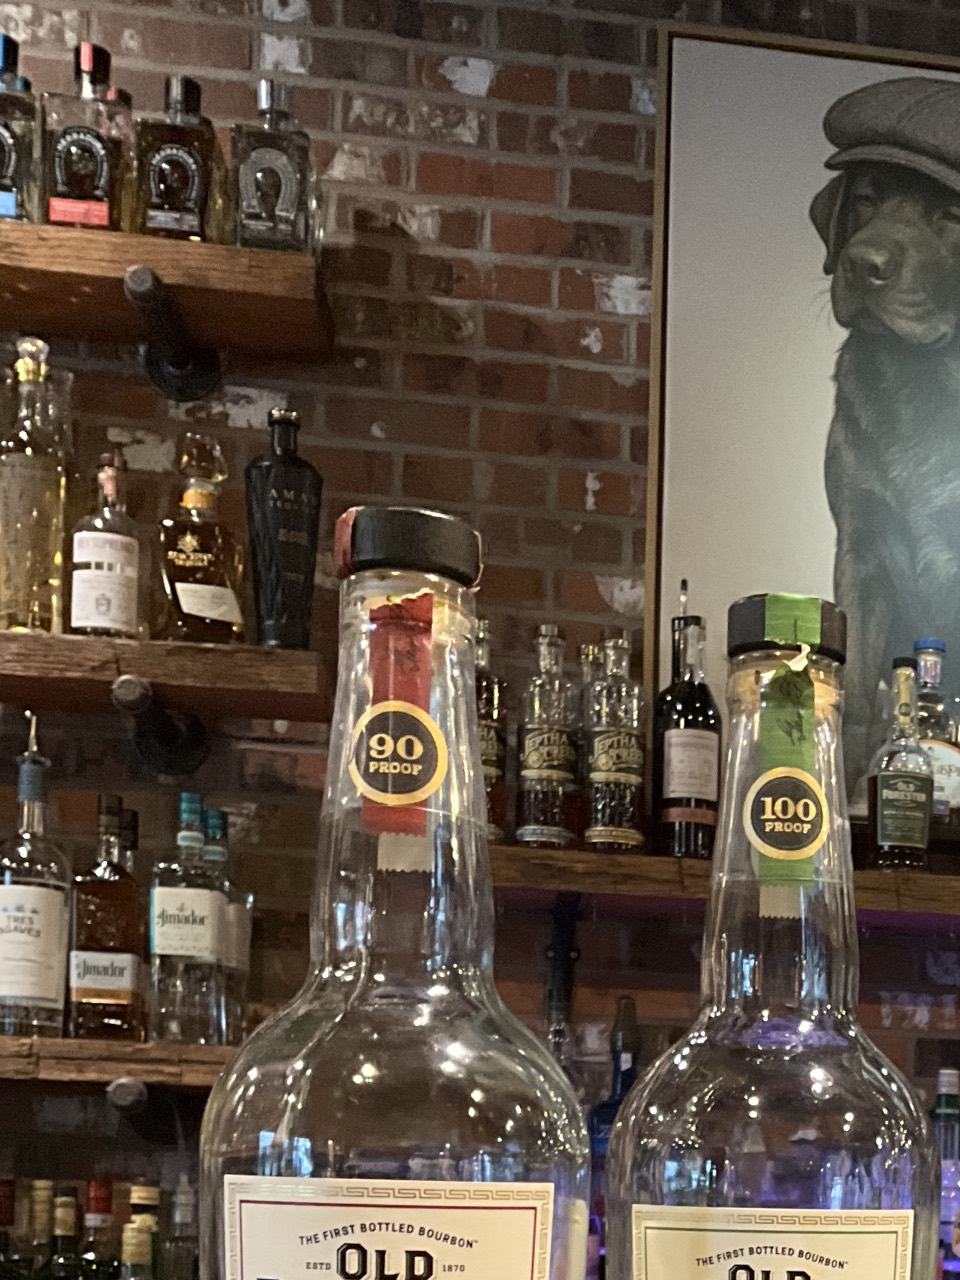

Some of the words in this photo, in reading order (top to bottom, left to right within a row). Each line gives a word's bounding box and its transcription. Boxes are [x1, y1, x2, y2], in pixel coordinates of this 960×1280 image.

[369, 733, 423, 760] 90
[369, 761, 422, 775] PROOF
[760, 796, 817, 822] 100
[764, 820, 812, 834] PROOF
[299, 1233, 320, 1246] THE
[323, 1224, 355, 1241] FIRST
[360, 1222, 414, 1234] BOTTLED
[696, 1256, 714, 1267] THE
[717, 1248, 744, 1263] FIRST
[748, 1246, 795, 1257] BOTTLED
[306, 1262, 331, 1270] ESTD
[442, 1264, 465, 1273] 1870
